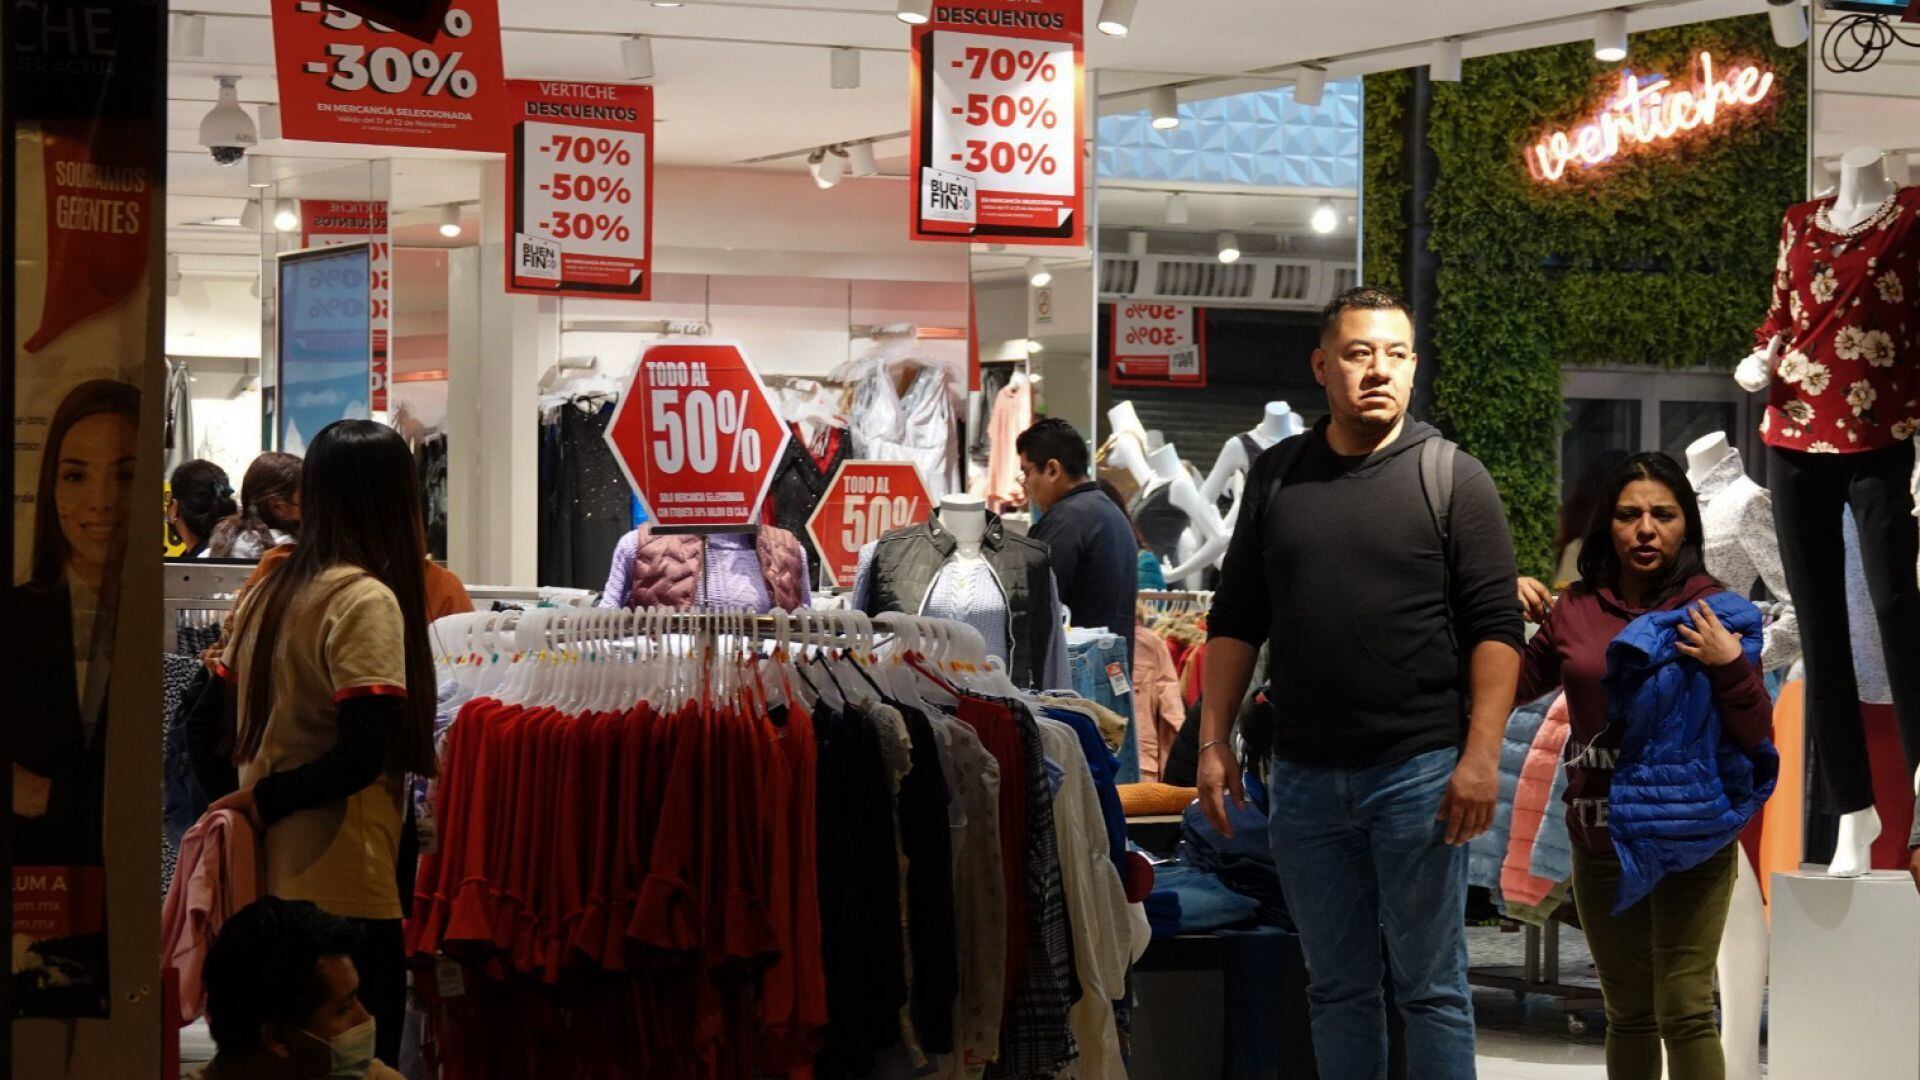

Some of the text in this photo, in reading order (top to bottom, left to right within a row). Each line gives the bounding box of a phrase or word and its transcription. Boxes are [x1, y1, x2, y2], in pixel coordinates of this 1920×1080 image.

[936, 7, 1064, 29] DESCUENTOS
[304, 43, 478, 99] -30%
[951, 47, 1056, 82] -70%
[539, 83, 616, 99] VERTICHE
[525, 101, 637, 121] DESCUENTOS
[951, 94, 1057, 129] -50%
[1532, 51, 1774, 181] vertiche
[539, 135, 631, 166] -70%
[951, 140, 1056, 175] -30%
[539, 173, 631, 204] -50%
[931, 179, 967, 197] BUEN
[539, 211, 630, 242] -30%
[523, 242, 554, 258] BUEN
[646, 361, 710, 387] TODO AL
[651, 389, 761, 474] 50%
[843, 476, 890, 494] TODO AL
[51, 875, 68, 892] A
